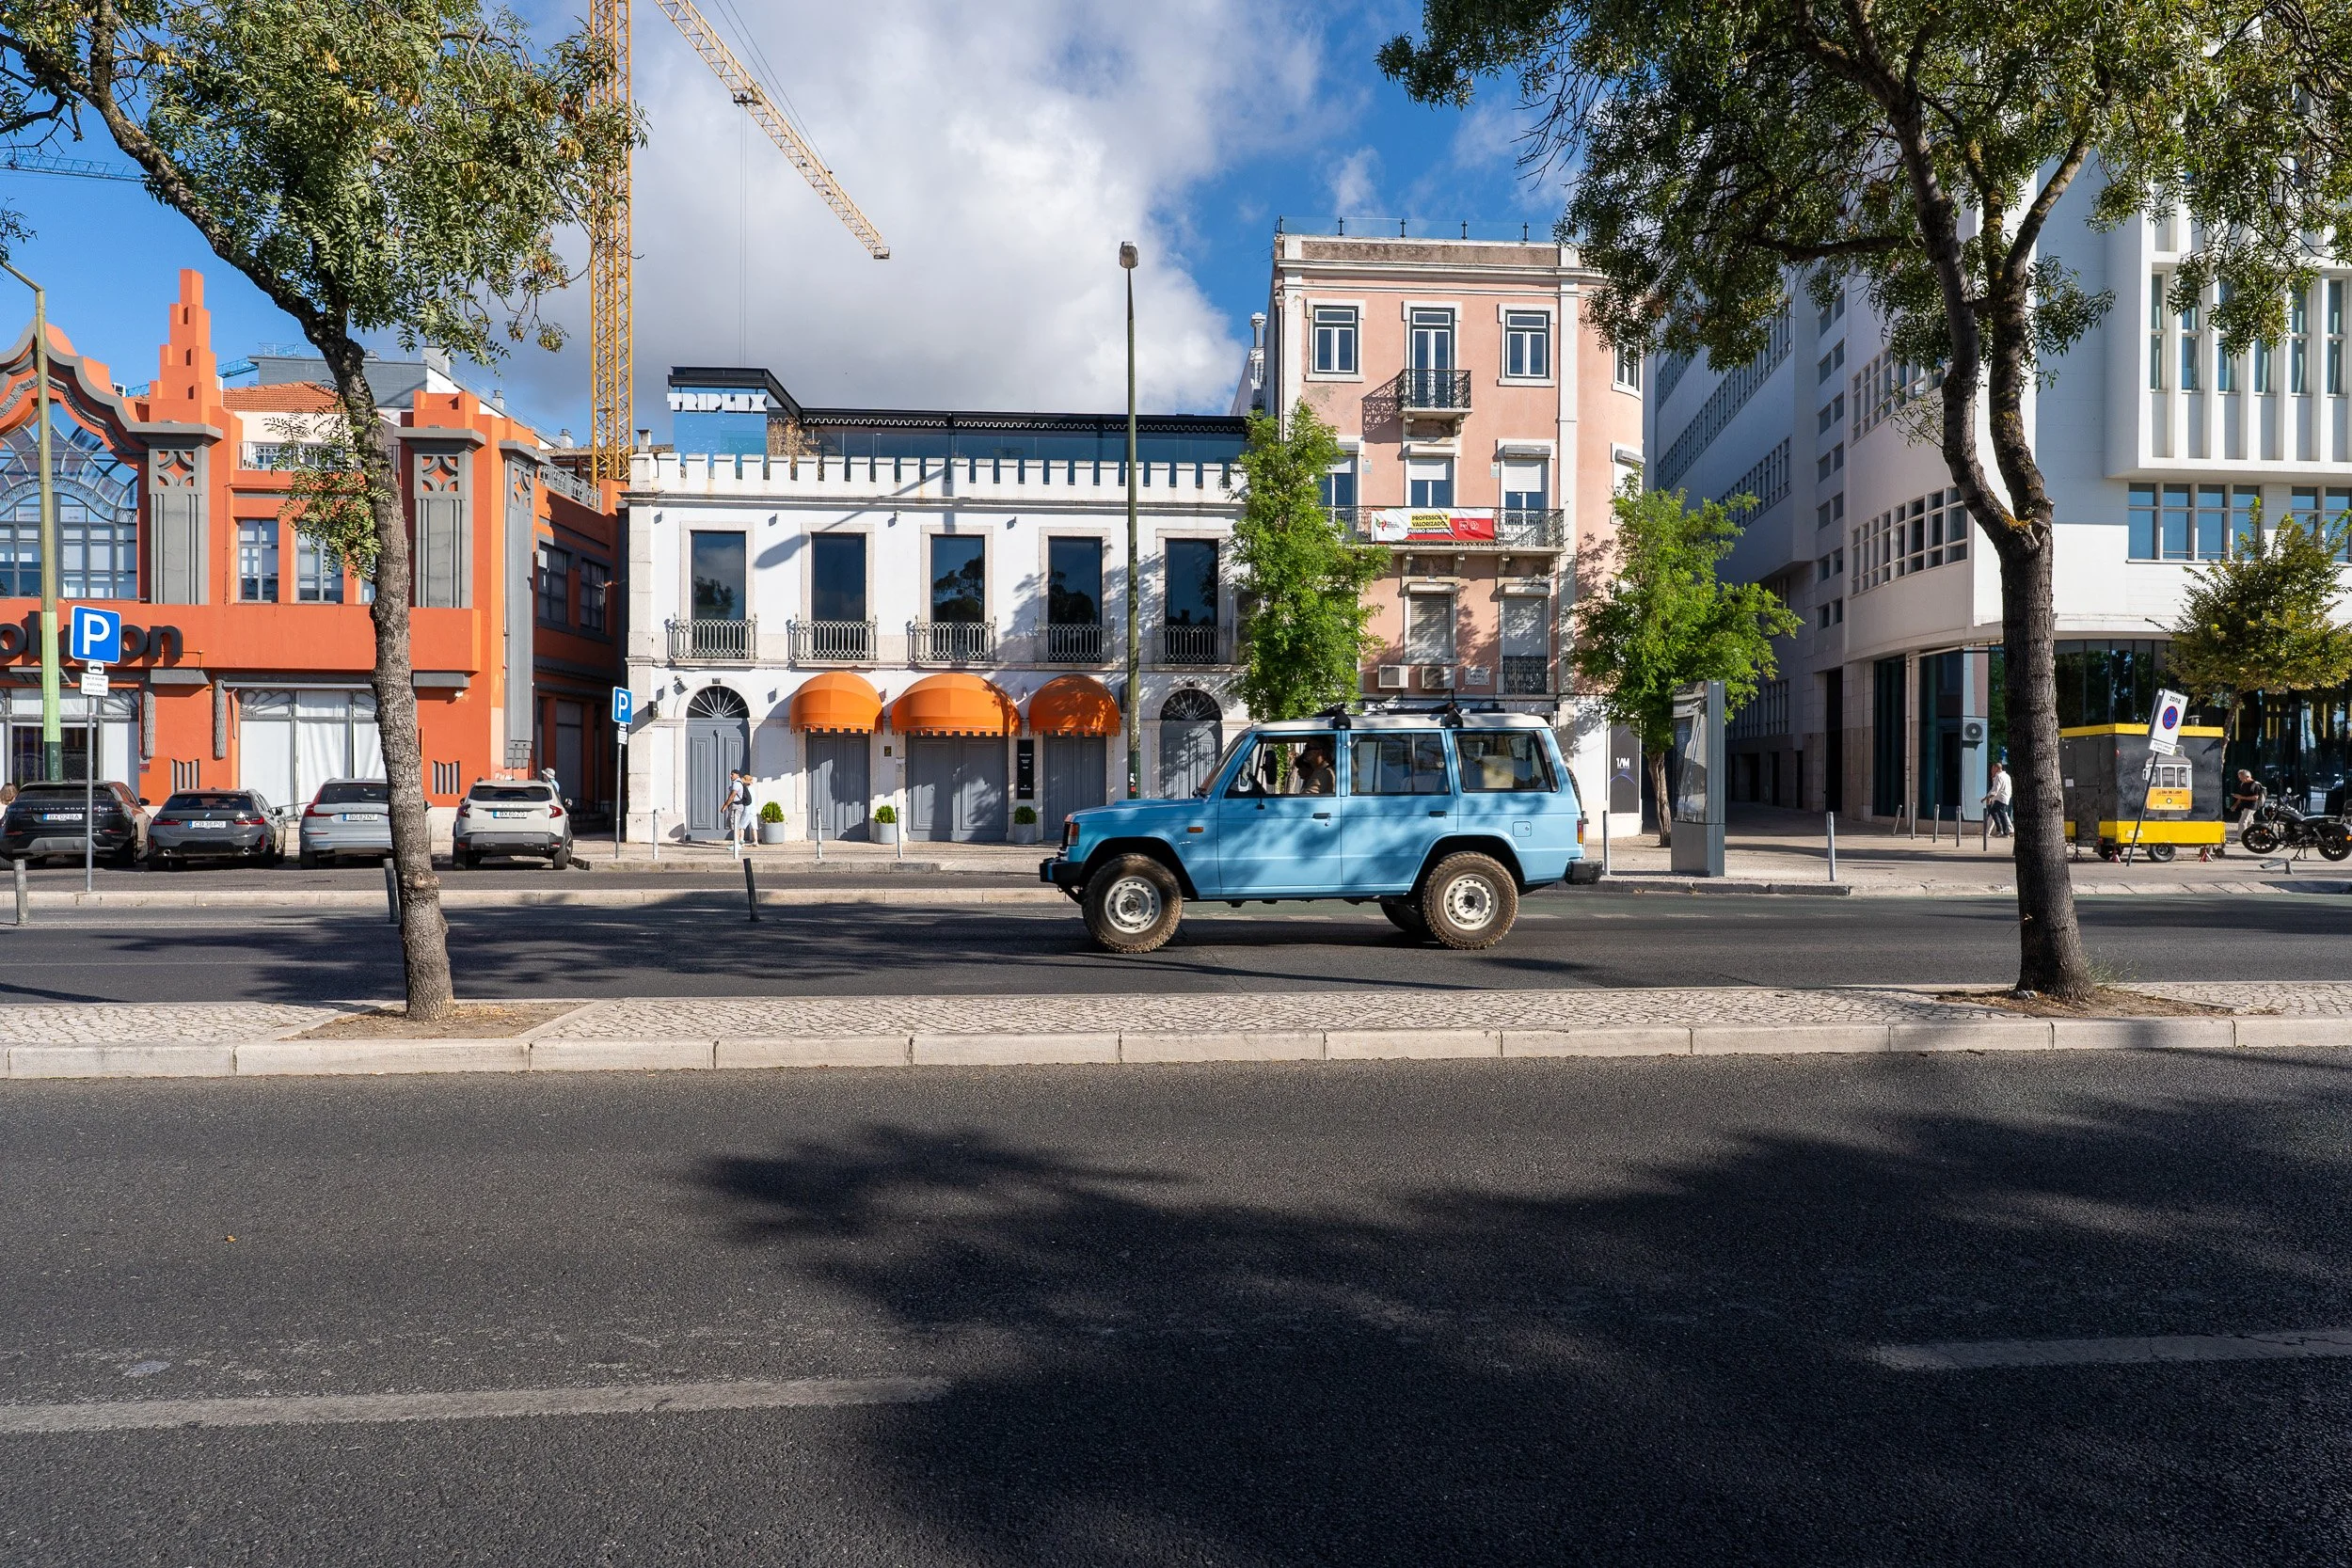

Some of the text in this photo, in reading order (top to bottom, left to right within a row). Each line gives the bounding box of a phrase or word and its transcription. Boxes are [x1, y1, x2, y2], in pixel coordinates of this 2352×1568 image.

[667, 393, 768, 411] TRIPLEX
[83, 612, 111, 656] P
[617, 691, 629, 719] P
